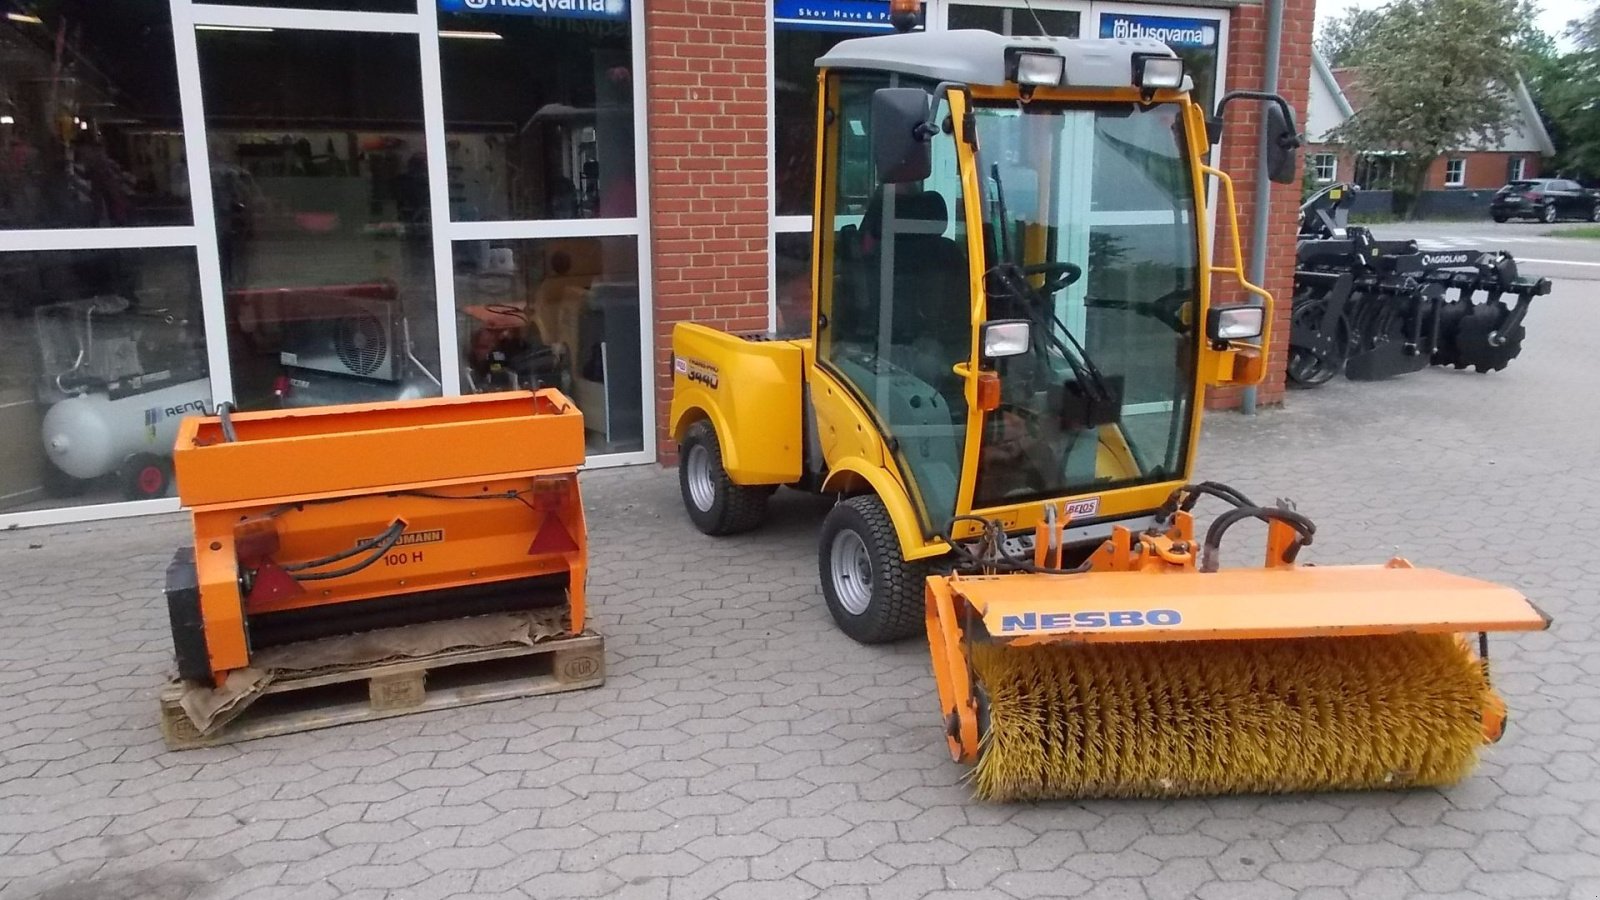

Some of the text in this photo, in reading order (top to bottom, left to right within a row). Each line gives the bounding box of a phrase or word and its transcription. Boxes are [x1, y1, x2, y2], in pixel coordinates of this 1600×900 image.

[798, 8, 826, 17] Skov
[833, 9, 861, 19] Have
[1129, 23, 1202, 42] Husqvarna
[1429, 254, 1468, 264] AGROLAND
[165, 400, 204, 417] RENO
[1068, 502, 1096, 514] BELOS
[384, 551, 423, 567] 100 H
[1002, 609, 1182, 632] NESBO
